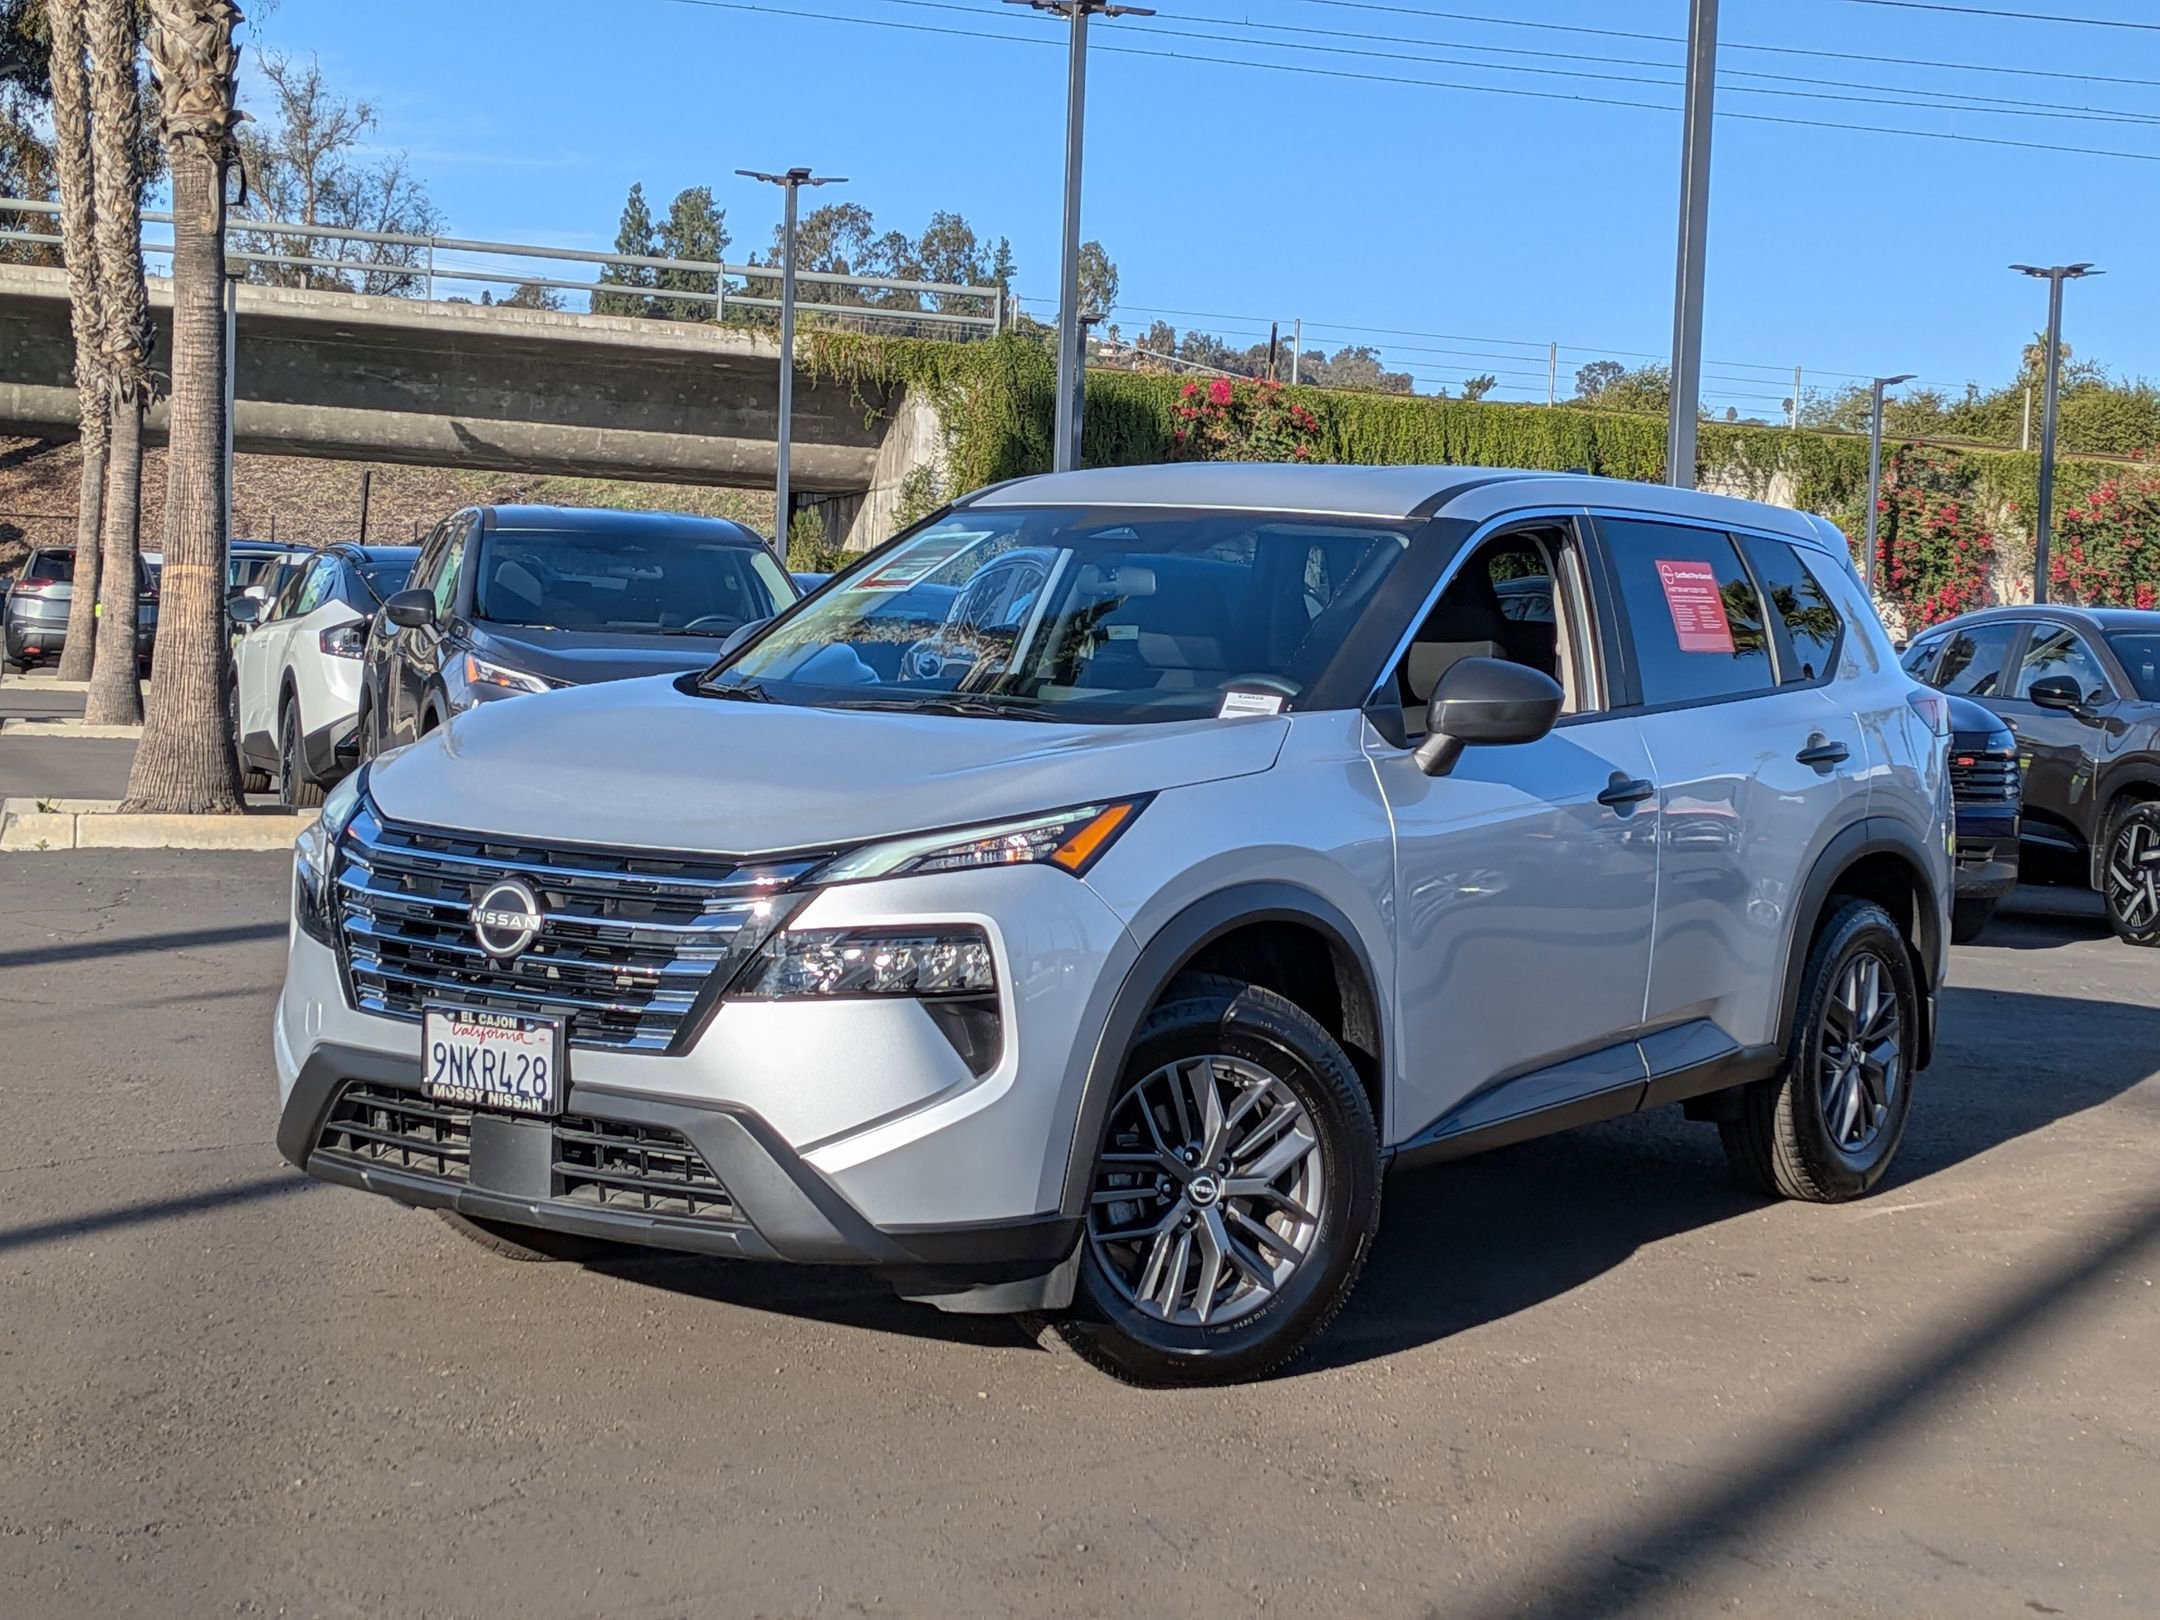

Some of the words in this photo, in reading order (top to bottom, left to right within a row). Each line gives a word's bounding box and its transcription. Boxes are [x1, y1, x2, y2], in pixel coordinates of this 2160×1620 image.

[471, 909, 541, 931] NISSAN
[460, 1011, 476, 1023] EL
[478, 1013, 518, 1029] CAJON
[451, 1022, 534, 1045] California
[432, 1042, 547, 1098] 9NKR428
[432, 1084, 485, 1103] MOSSY
[487, 1091, 543, 1113] NISSAN
